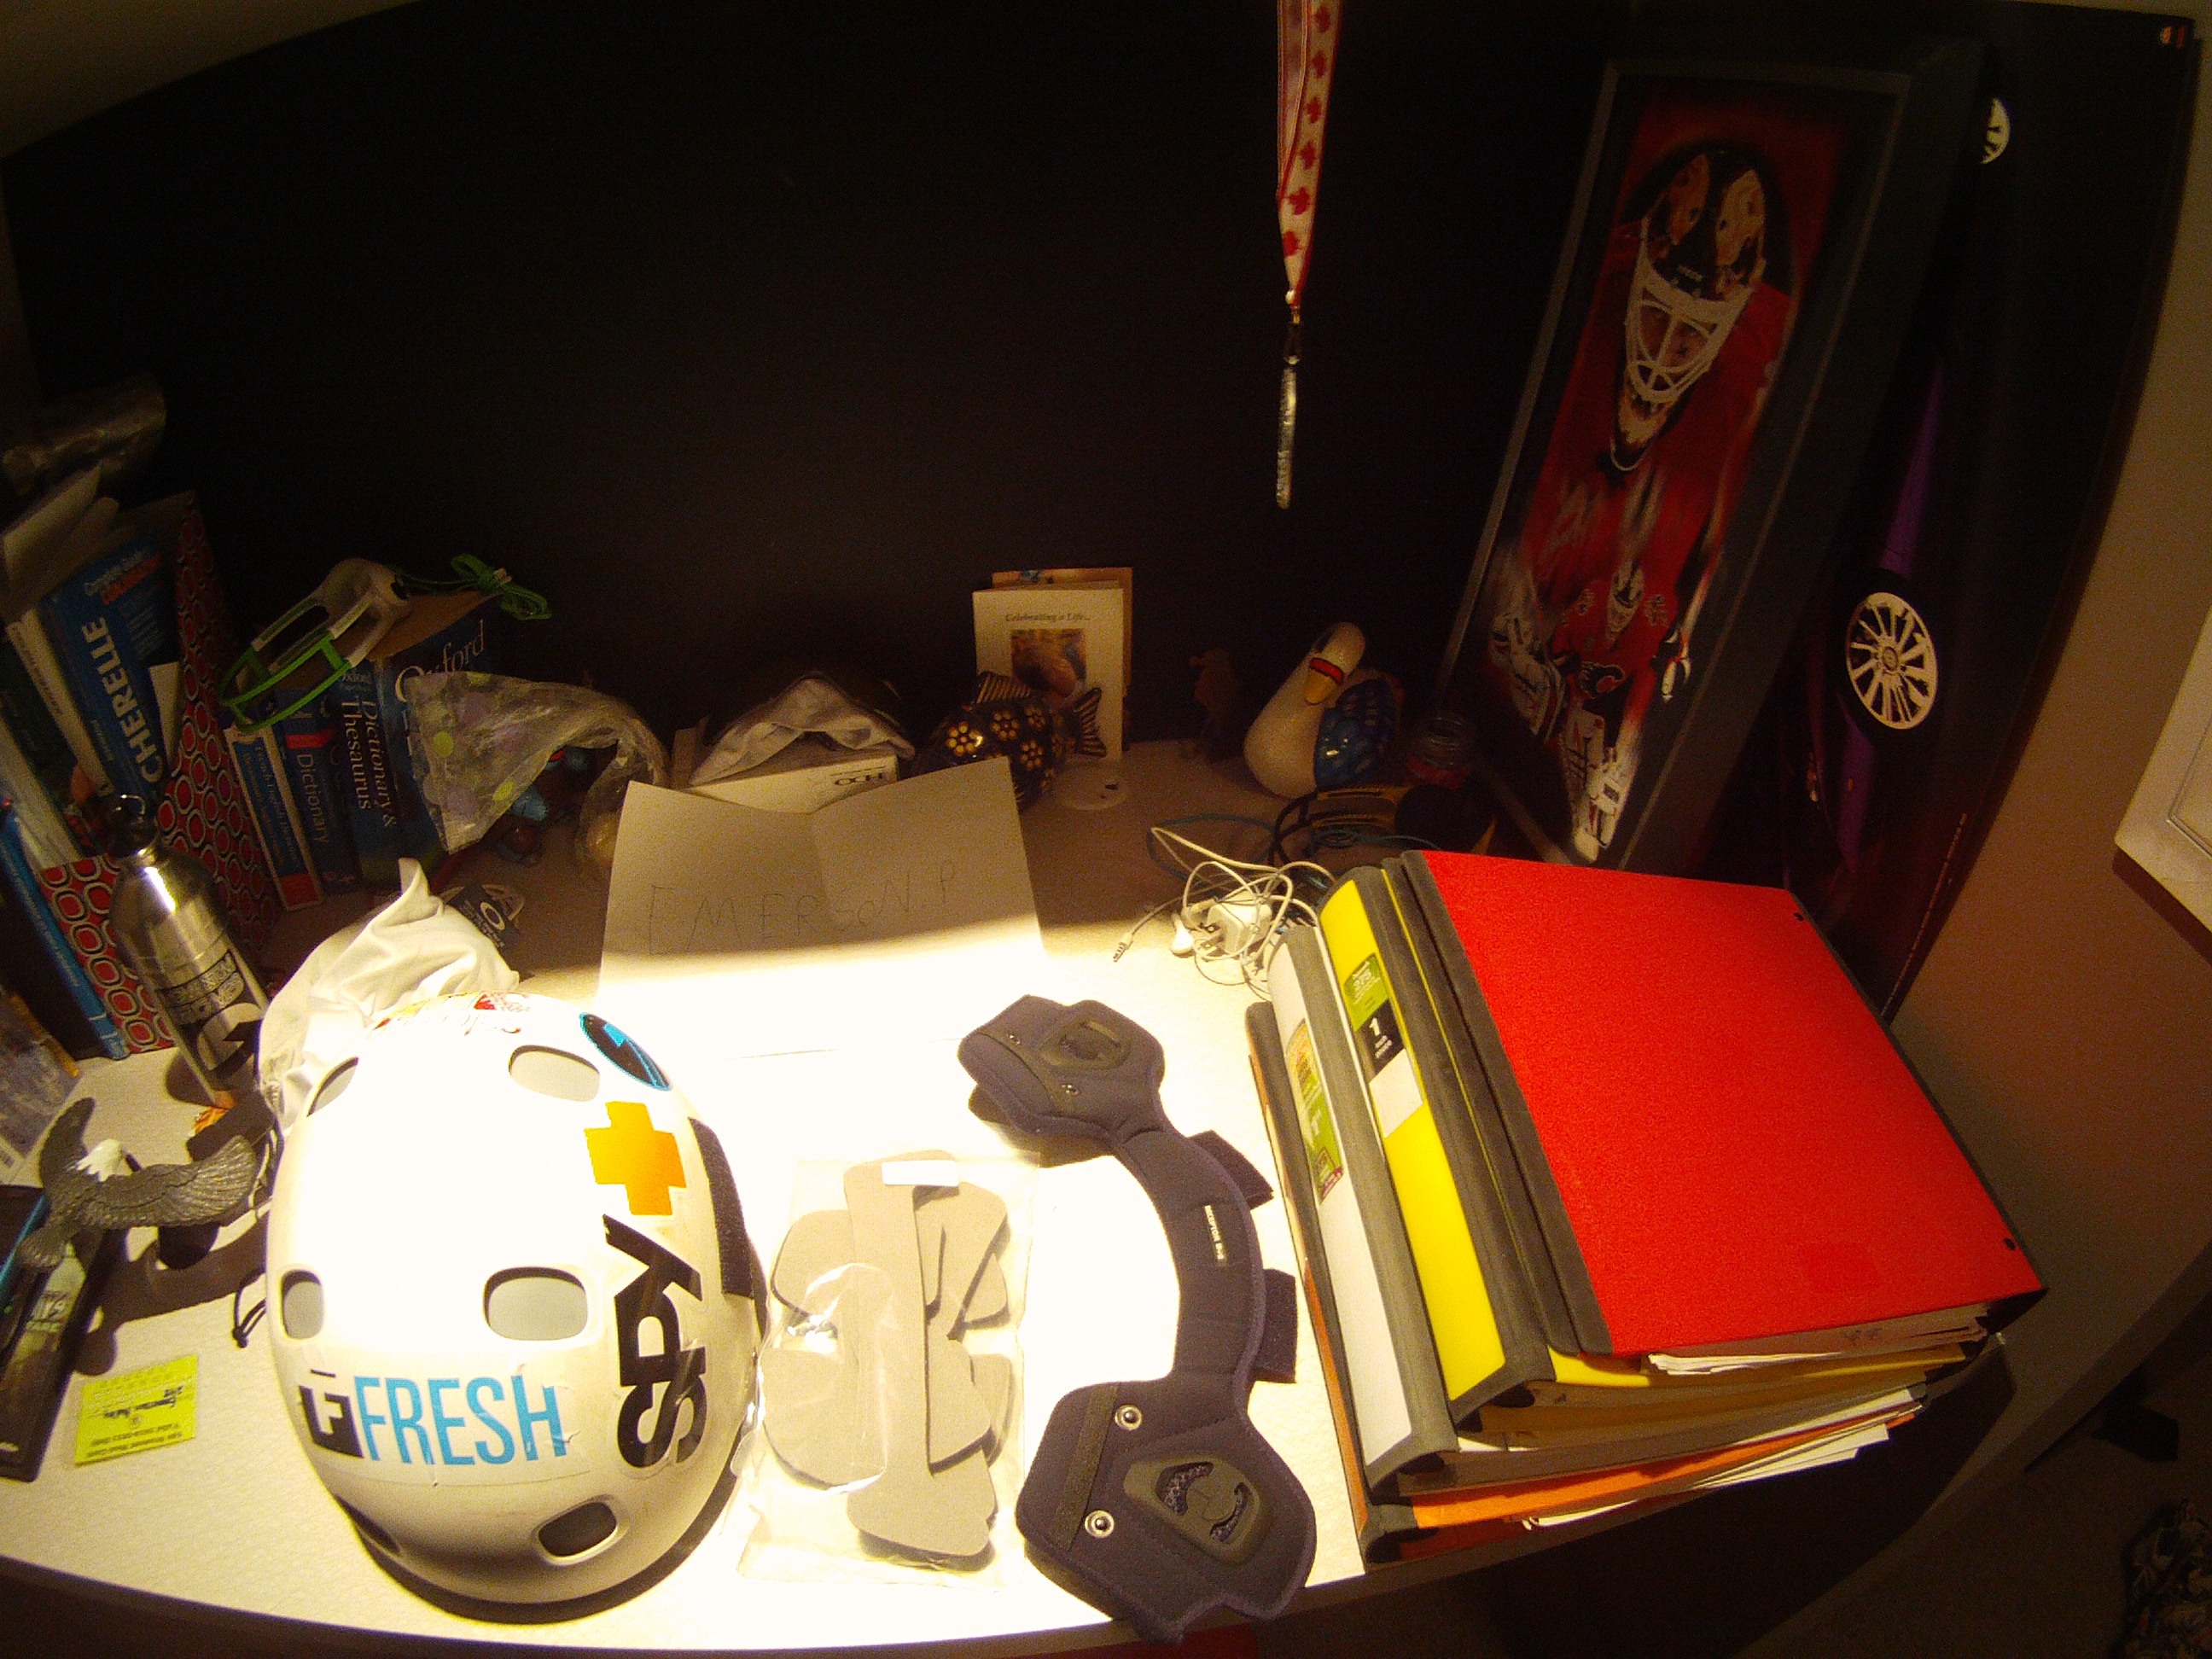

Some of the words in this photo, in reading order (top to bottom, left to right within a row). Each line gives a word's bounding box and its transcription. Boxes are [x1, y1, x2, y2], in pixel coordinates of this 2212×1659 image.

[395, 619, 486, 702] Oford
[1005, 614, 1057, 623] Celebrating
[81, 617, 164, 783] CHERELLE
[296, 753, 329, 843] Dictionary
[341, 700, 372, 811] Thesaurus
[362, 699, 393, 810] Dictionary
[381, 812, 397, 829] &
[1369, 1017, 1381, 1036] 1
[602, 1214, 707, 1467] SPY
[353, 1373, 568, 1466] FRESH
